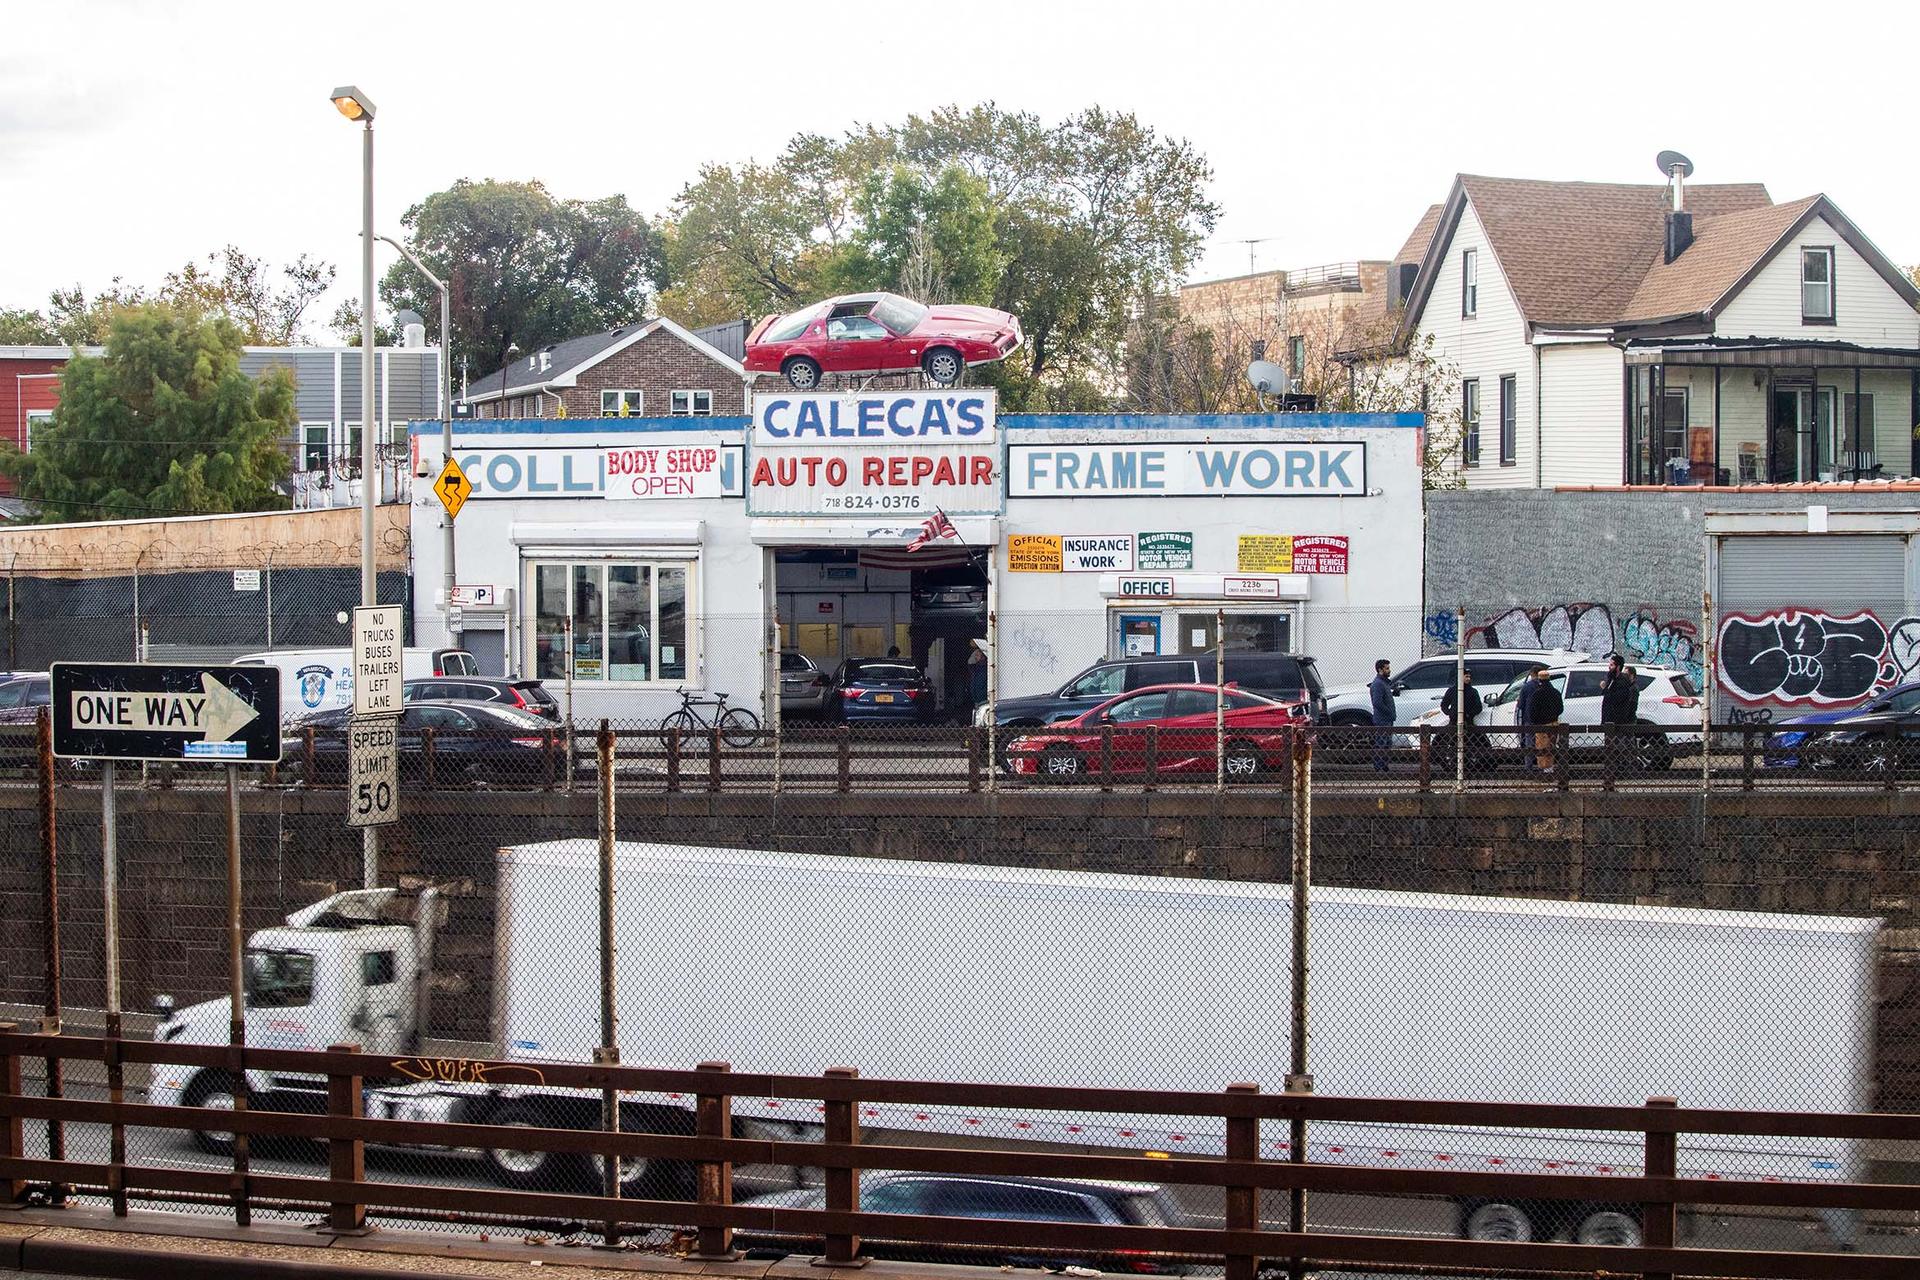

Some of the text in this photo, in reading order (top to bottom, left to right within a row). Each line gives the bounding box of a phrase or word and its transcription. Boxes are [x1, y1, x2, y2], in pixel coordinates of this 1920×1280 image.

[763, 398, 985, 438] CALECA'S
[607, 448, 717, 475] BODY SHOP
[751, 456, 848, 487] AUTO
[862, 455, 993, 487] REPAIR
[1027, 449, 1355, 490] FRAME WORK
[631, 476, 694, 495] OPEN
[825, 498, 841, 509] 718
[1013, 535, 1057, 548] OFFICIAL
[1064, 539, 1130, 552] INSURANCE
[1139, 533, 1192, 546] REGISTERED
[1293, 537, 1347, 549] REGISTERED
[1010, 554, 1059, 562] EMISSIONS
[1079, 555, 1116, 567] WORK
[1169, 561, 1188, 569] SHOP
[1294, 557, 1317, 565] MOTOR
[1009, 562, 1060, 571] INSPECTION STATION
[1294, 565, 1345, 573] RETAIL DEALER
[1122, 581, 1170, 595] OFFICE
[1241, 580, 1262, 588] 2236
[372, 613, 384, 626] NO
[362, 629, 395, 643] TRUCKS
[365, 645, 392, 659] BUSES
[359, 661, 399, 676] TRAILERS
[369, 678, 389, 692] LEFT
[368, 695, 391, 709] LANE
[76, 695, 207, 727] ONE WAY
[353, 730, 393, 749] SPEED
[358, 756, 389, 774] LIMIT
[357, 780, 391, 814] 50
